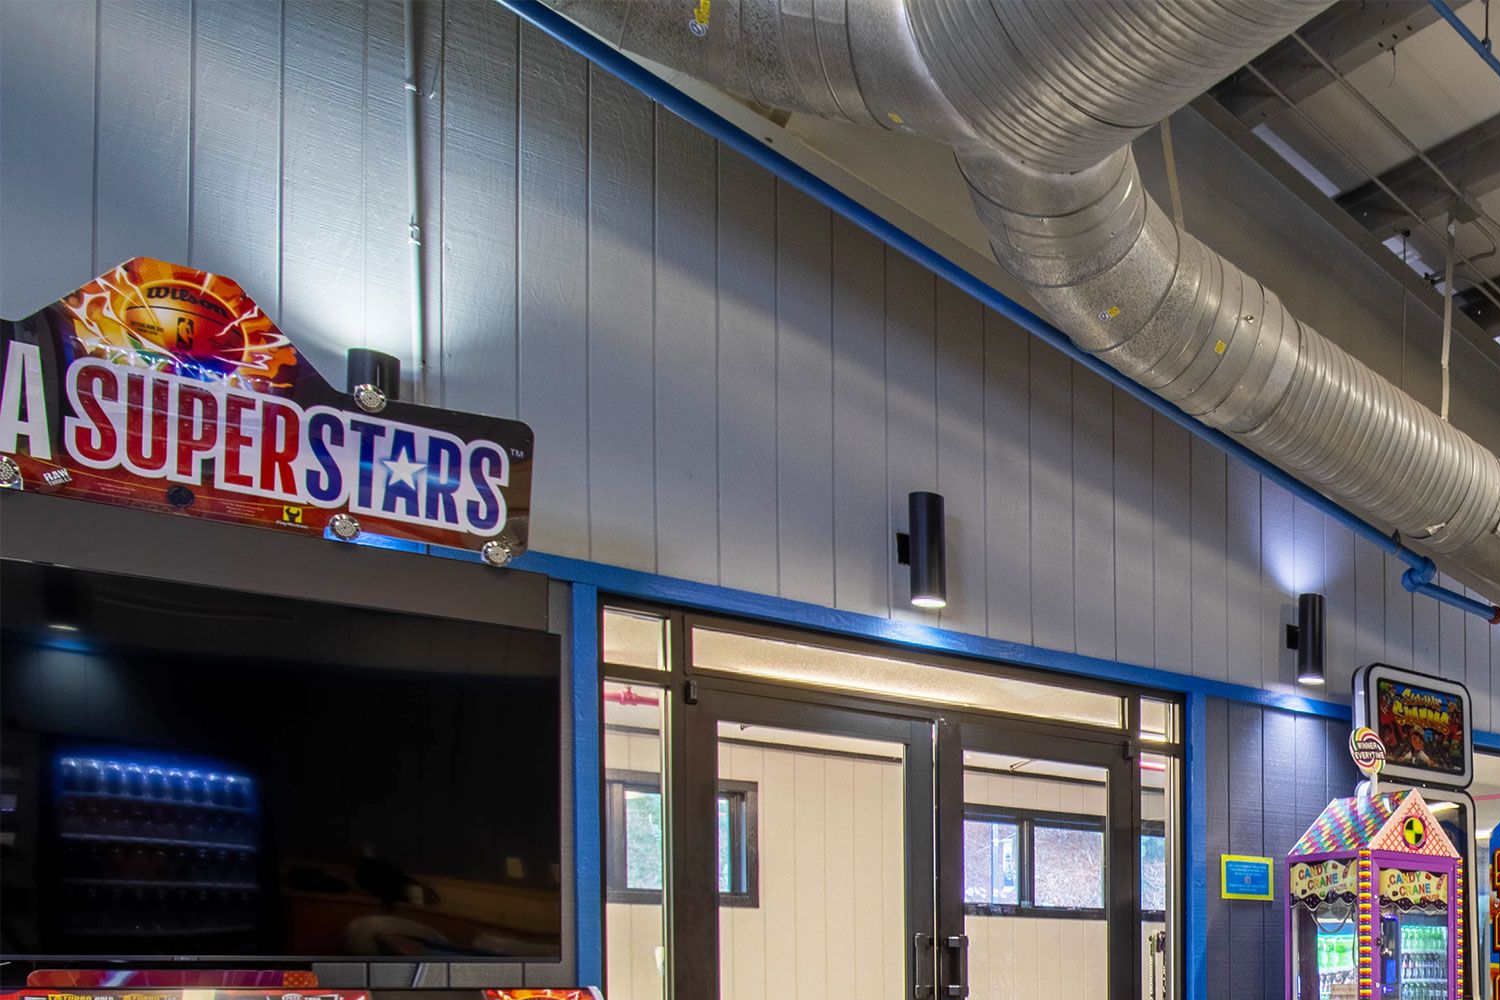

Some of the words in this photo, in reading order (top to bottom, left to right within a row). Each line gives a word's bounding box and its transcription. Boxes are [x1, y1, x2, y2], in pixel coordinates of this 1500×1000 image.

[1298, 862, 1329, 880] CANDY
[1389, 871, 1421, 885] CANDY
[1307, 873, 1338, 890] CRANE
[1399, 883, 1431, 896] CRANE
